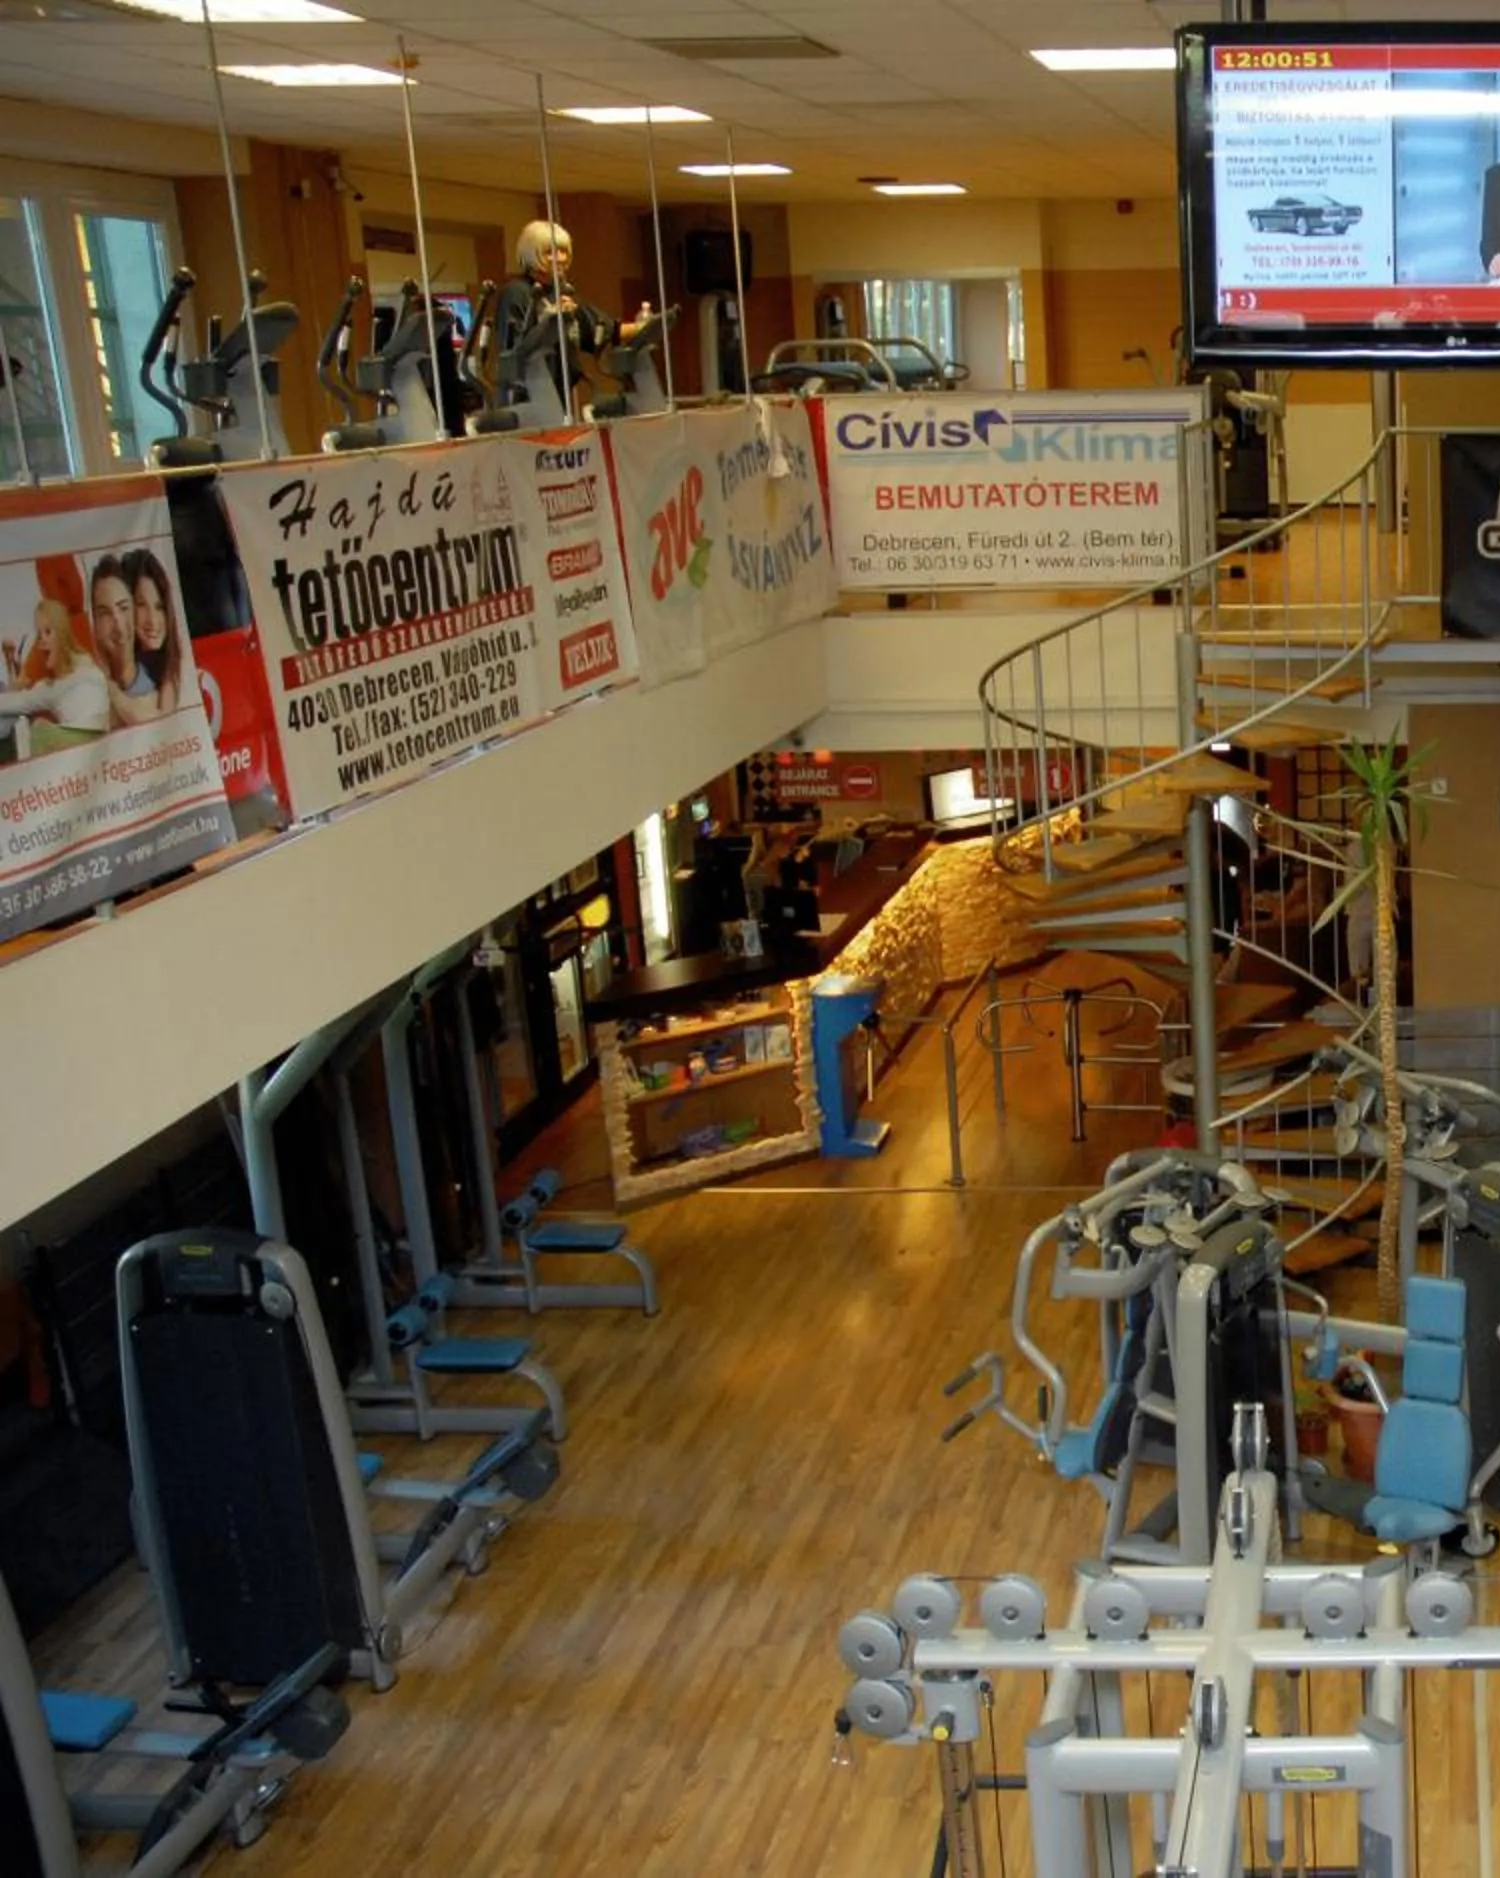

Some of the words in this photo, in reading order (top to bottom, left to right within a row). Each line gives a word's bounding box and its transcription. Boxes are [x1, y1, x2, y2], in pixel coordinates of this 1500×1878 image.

[1222, 51, 1333, 68] 12:00:51
[836, 406, 972, 451] Cívis
[875, 473, 1160, 511] BEMUTATÓTEREM
[862, 532, 961, 553] Debrecen,
[967, 530, 1029, 550] Füredi
[1034, 529, 1053, 549] út
[1083, 528, 1134, 551] (Bem
[1138, 528, 1175, 550] tér)
[886, 555, 908, 571] 06
[912, 553, 969, 571] 30/319
[973, 553, 995, 570] 63
[999, 553, 1019, 570] 71
[1035, 551, 1183, 569] www.civis-klima.h
[339, 659, 441, 711] Debrecen,
[448, 659, 518, 706] 340-229
[337, 695, 521, 792] www.tetocentrum.eu
[0, 773, 90, 822] ogfehérítés
[780, 785, 840, 797] ENTRANCE
